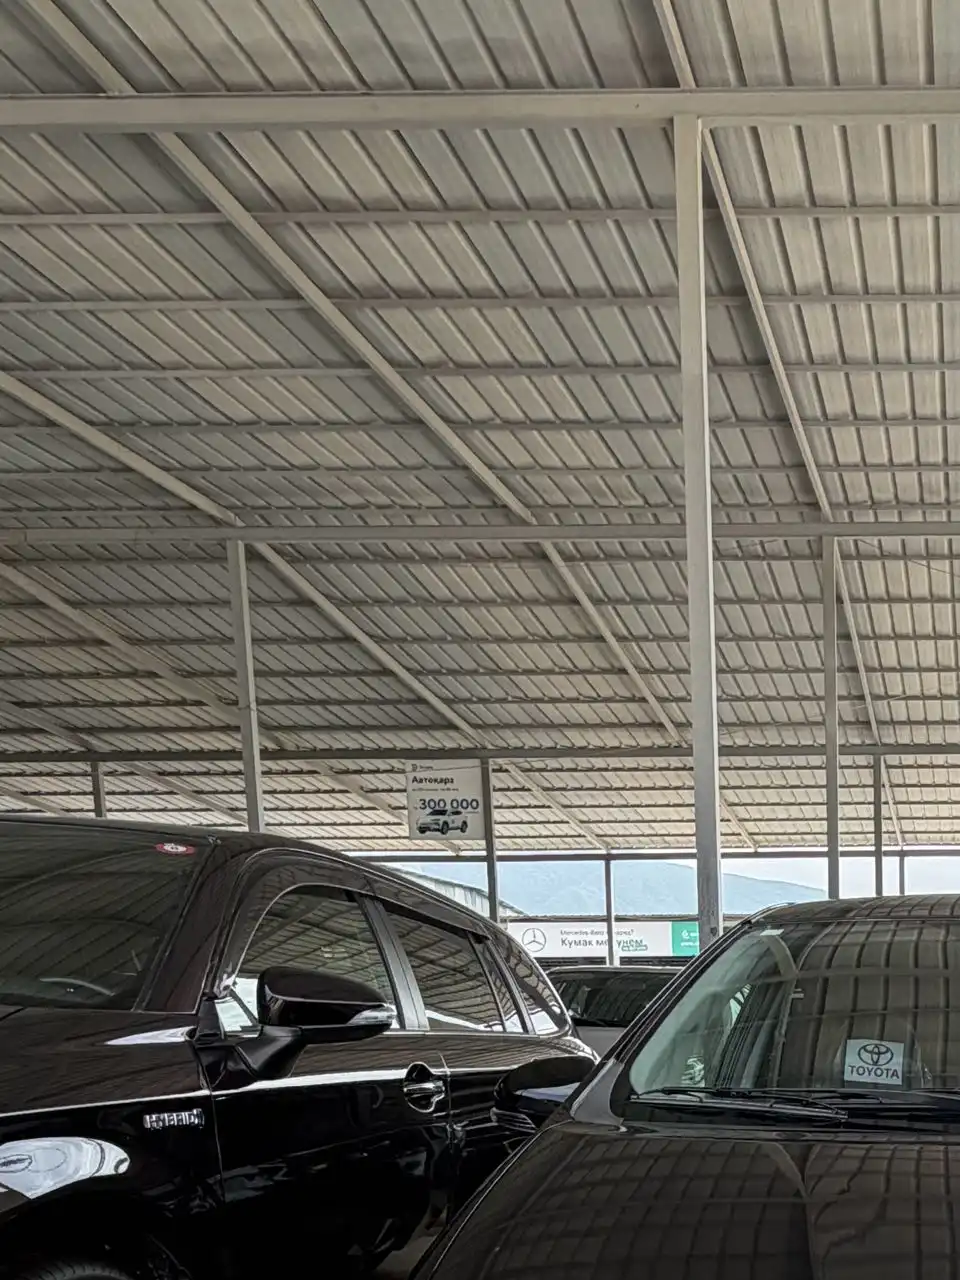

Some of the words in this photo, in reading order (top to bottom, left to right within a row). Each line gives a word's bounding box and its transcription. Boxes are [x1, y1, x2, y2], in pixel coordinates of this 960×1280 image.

[419, 798, 447, 810] 300
[450, 798, 479, 810] 000
[848, 1064, 900, 1080] TOYOTA
[143, 1109, 204, 1130] HYBRID
